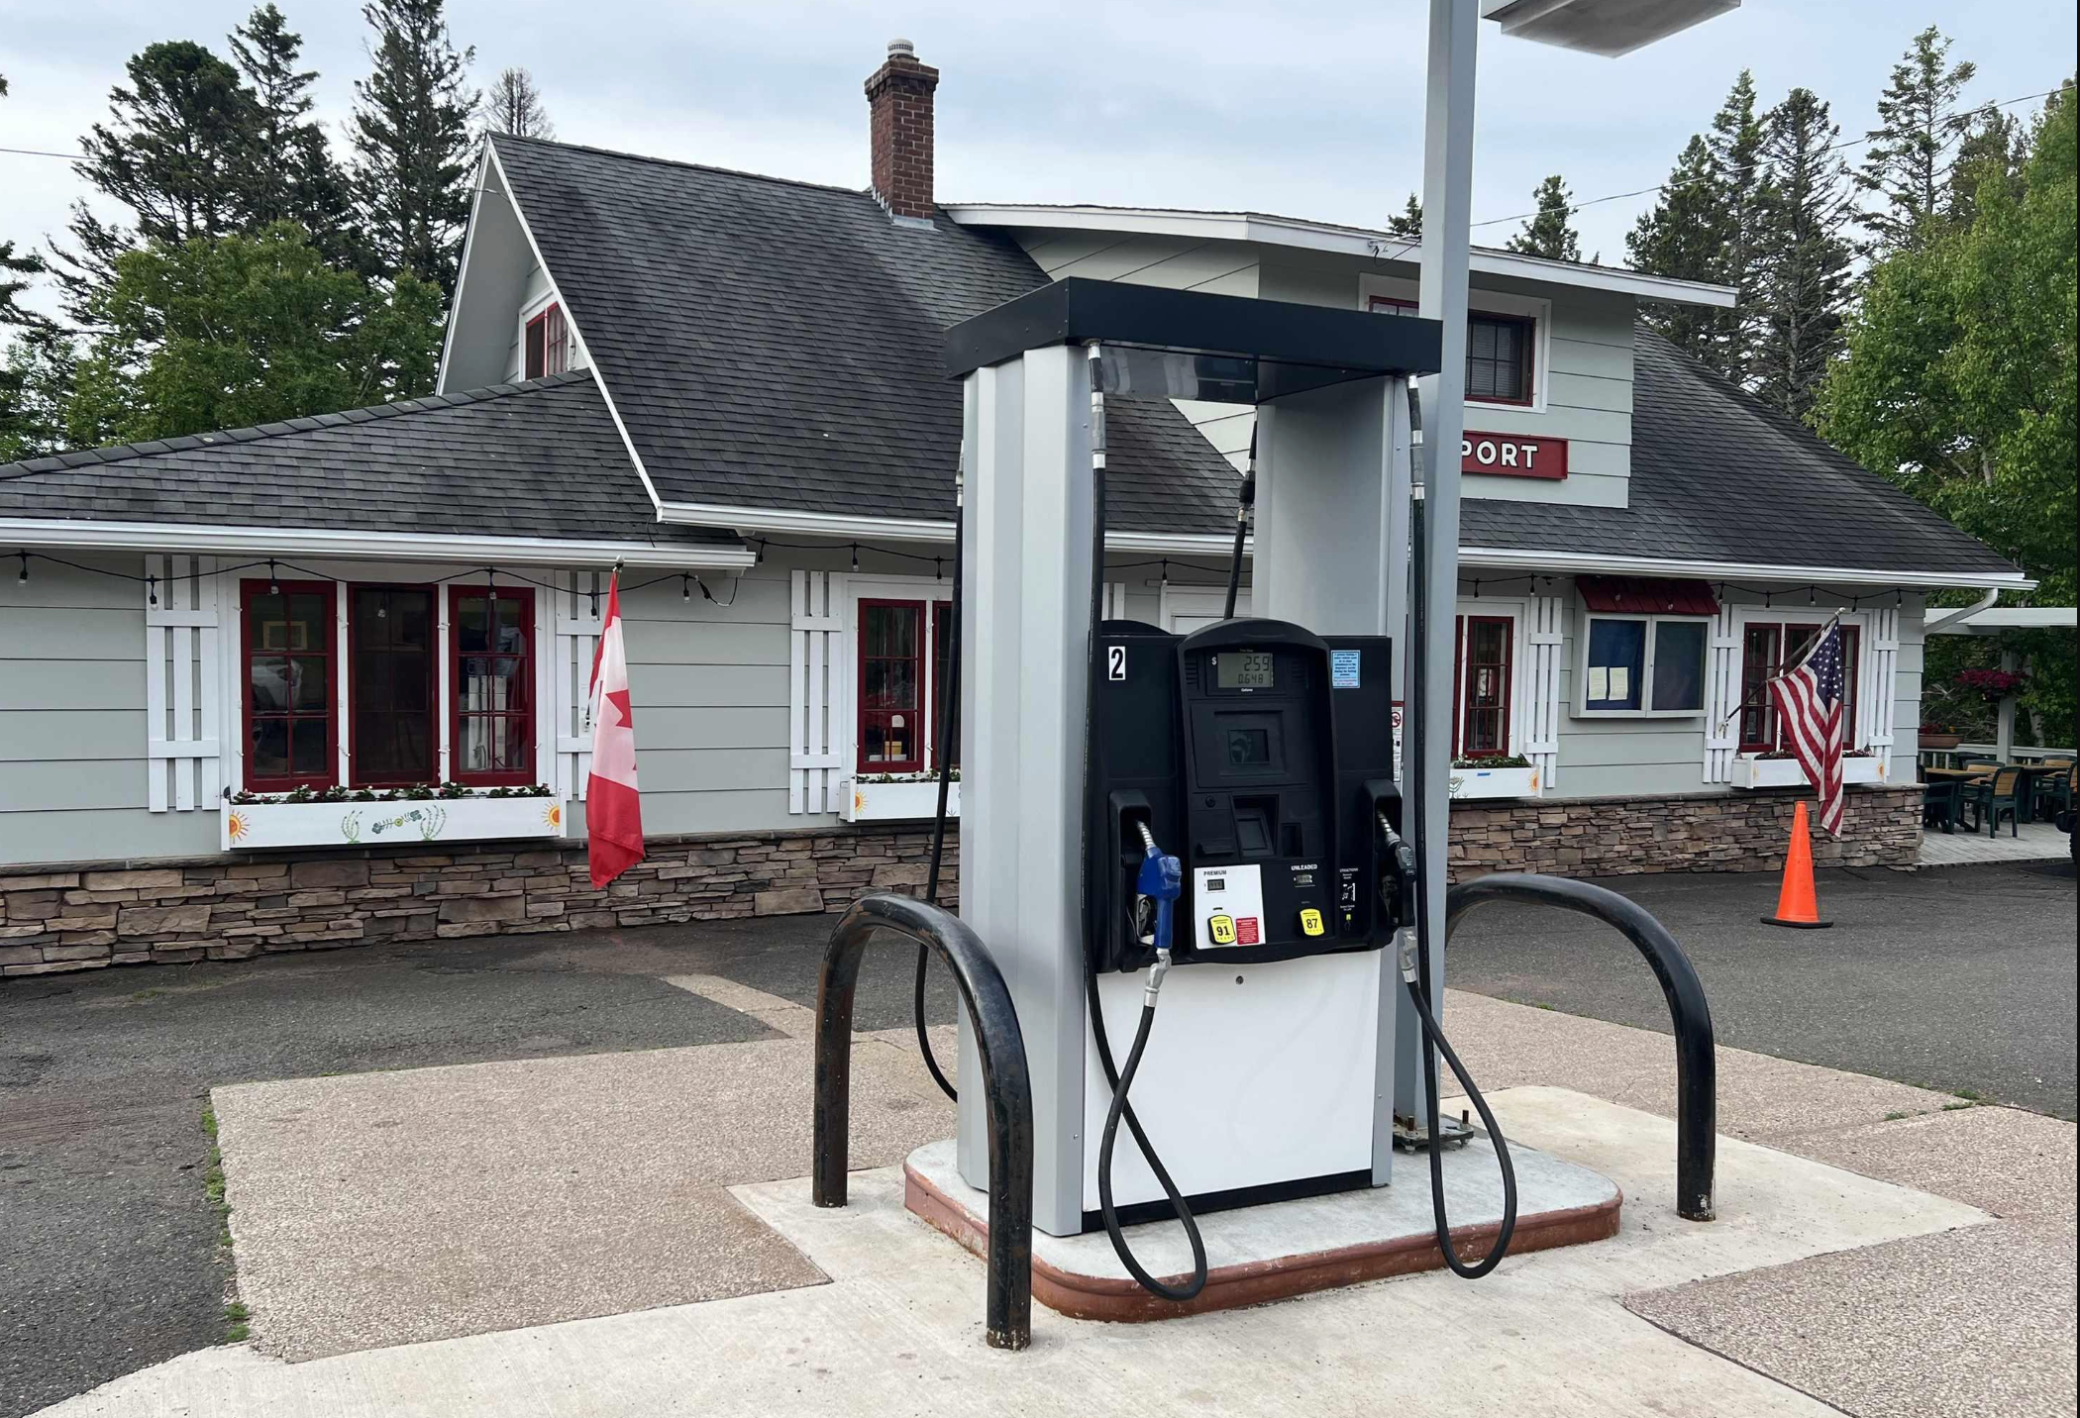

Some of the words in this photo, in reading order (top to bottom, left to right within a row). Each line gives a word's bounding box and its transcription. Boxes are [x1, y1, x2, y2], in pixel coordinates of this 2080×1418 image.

[1111, 648, 1124, 679] 2
[1306, 918, 1318, 929] 87
[1216, 925, 1230, 936] 91
